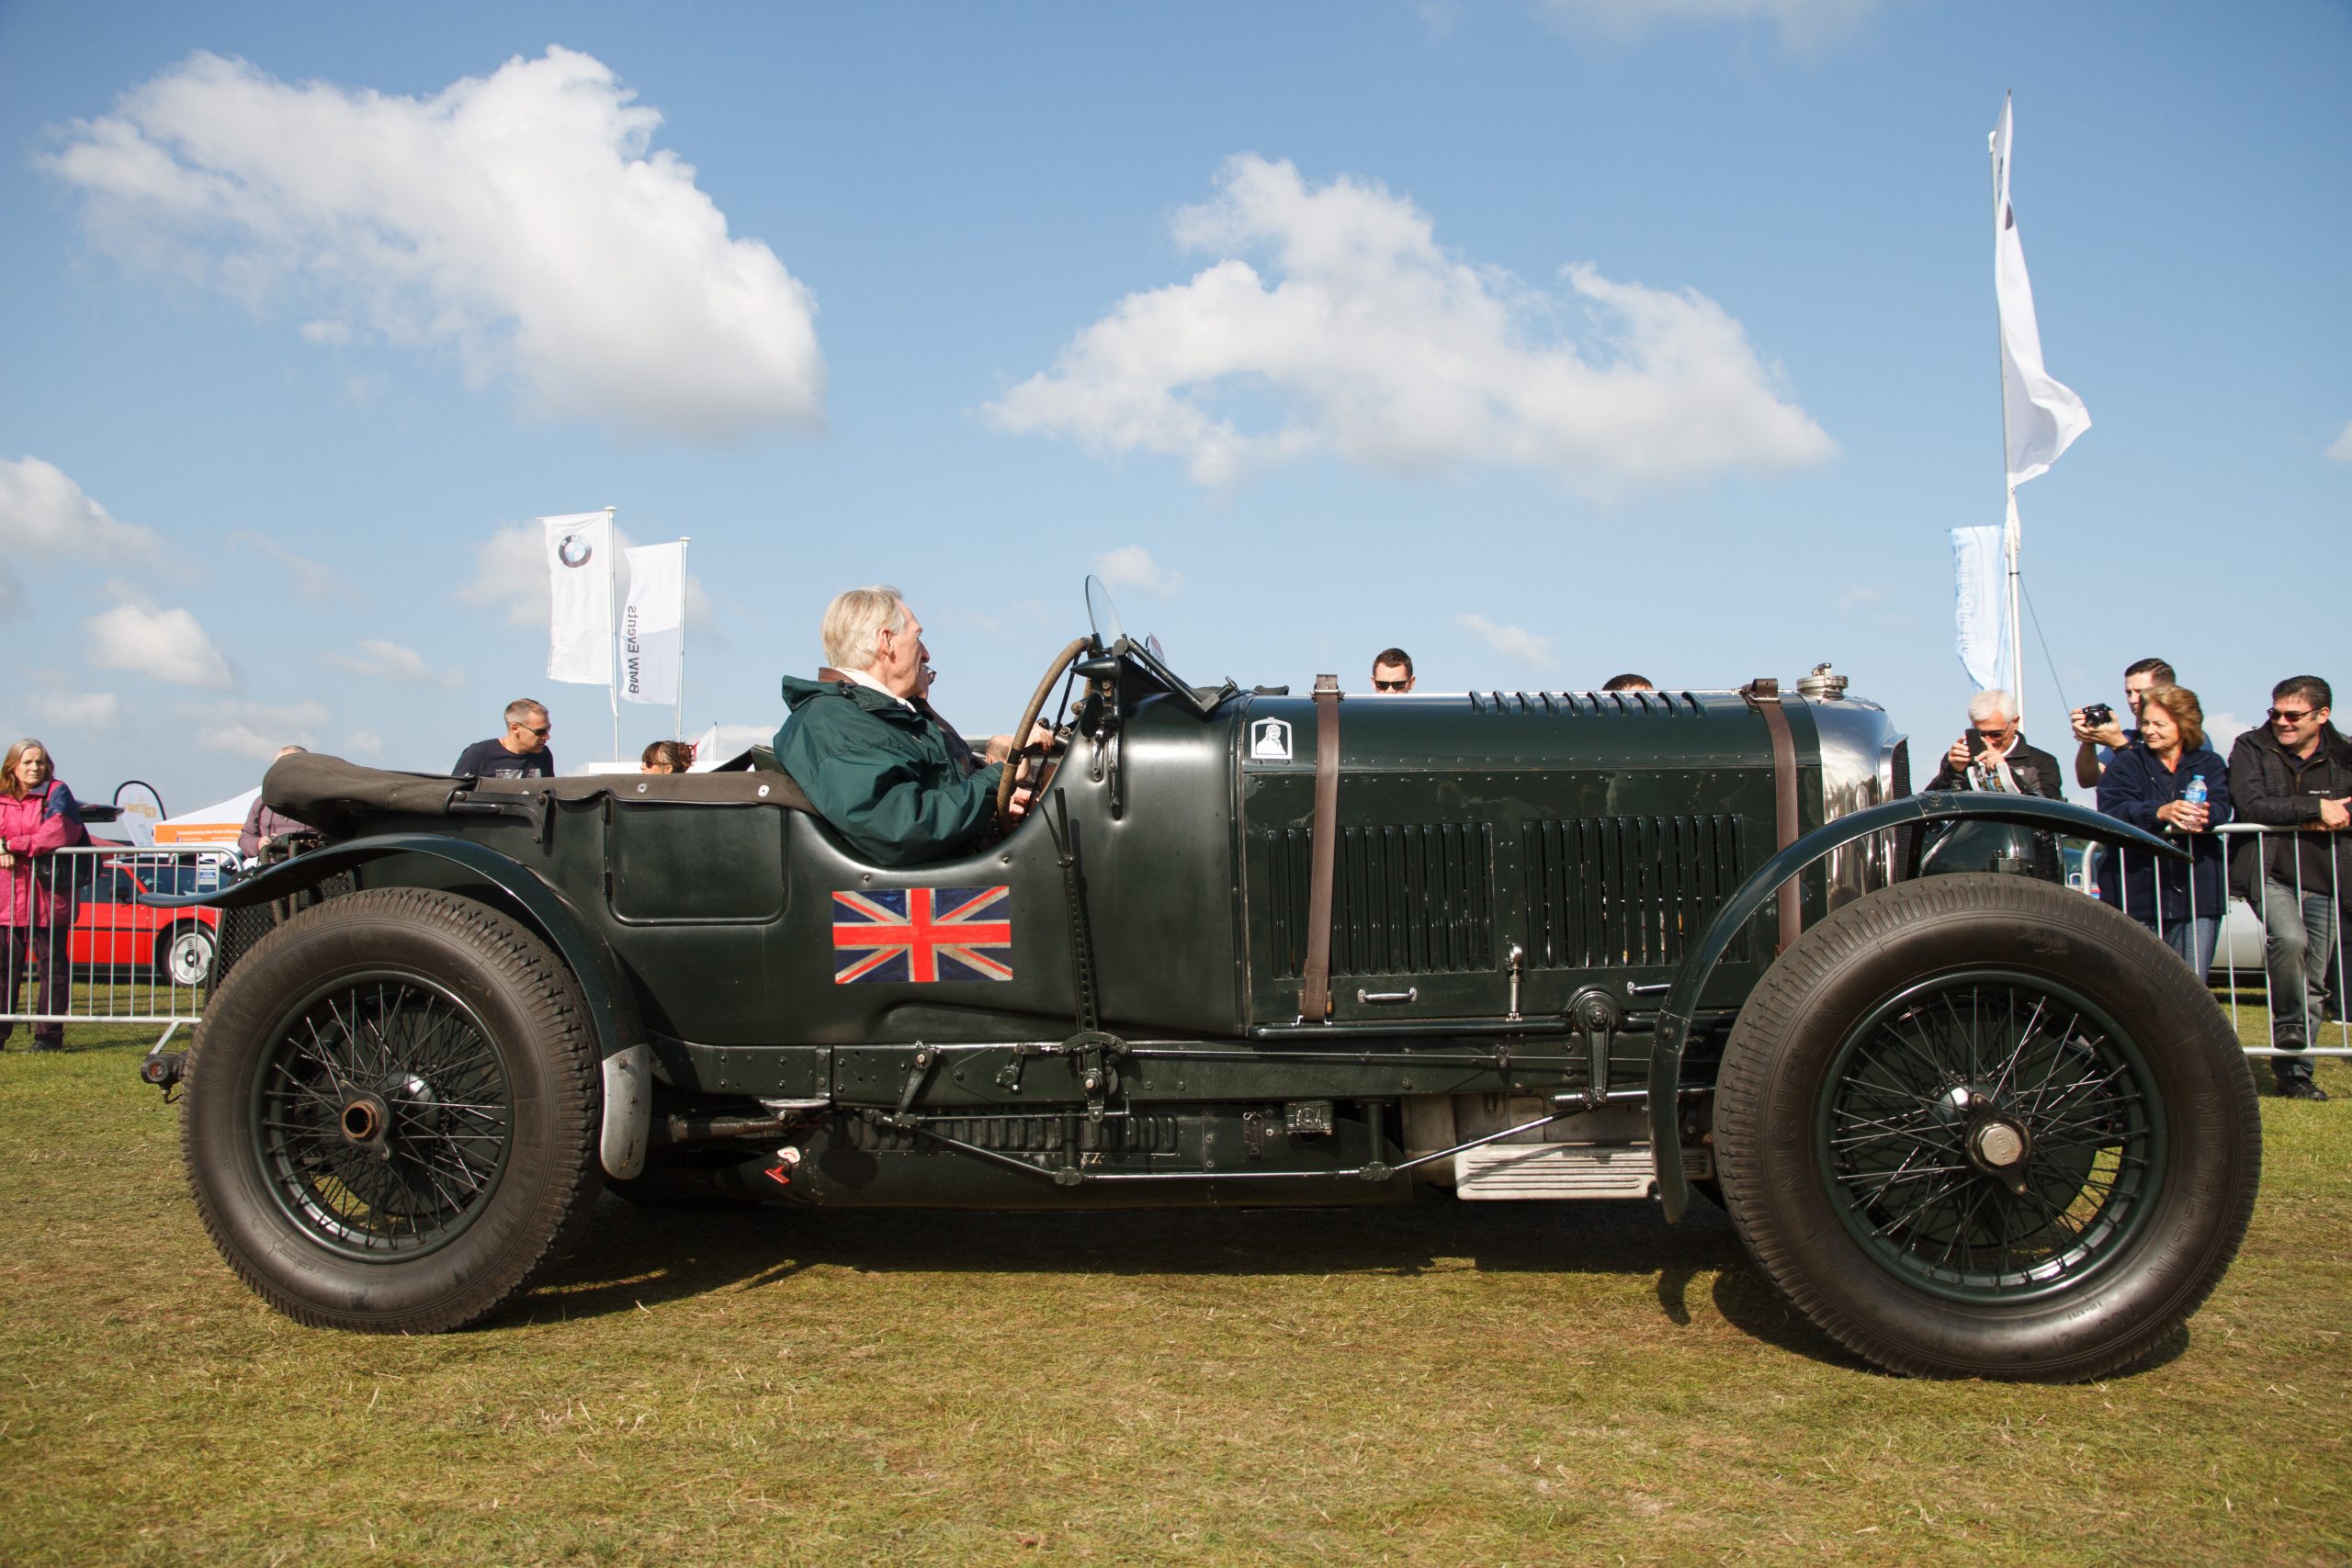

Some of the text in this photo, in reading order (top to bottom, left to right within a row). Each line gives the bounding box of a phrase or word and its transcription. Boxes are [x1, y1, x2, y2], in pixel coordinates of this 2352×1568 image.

[199, 948, 307, 1094] MICHELIN
[1772, 998, 1847, 1192] MICHELIN
[2144, 1089, 2229, 1288] MICHELIN
